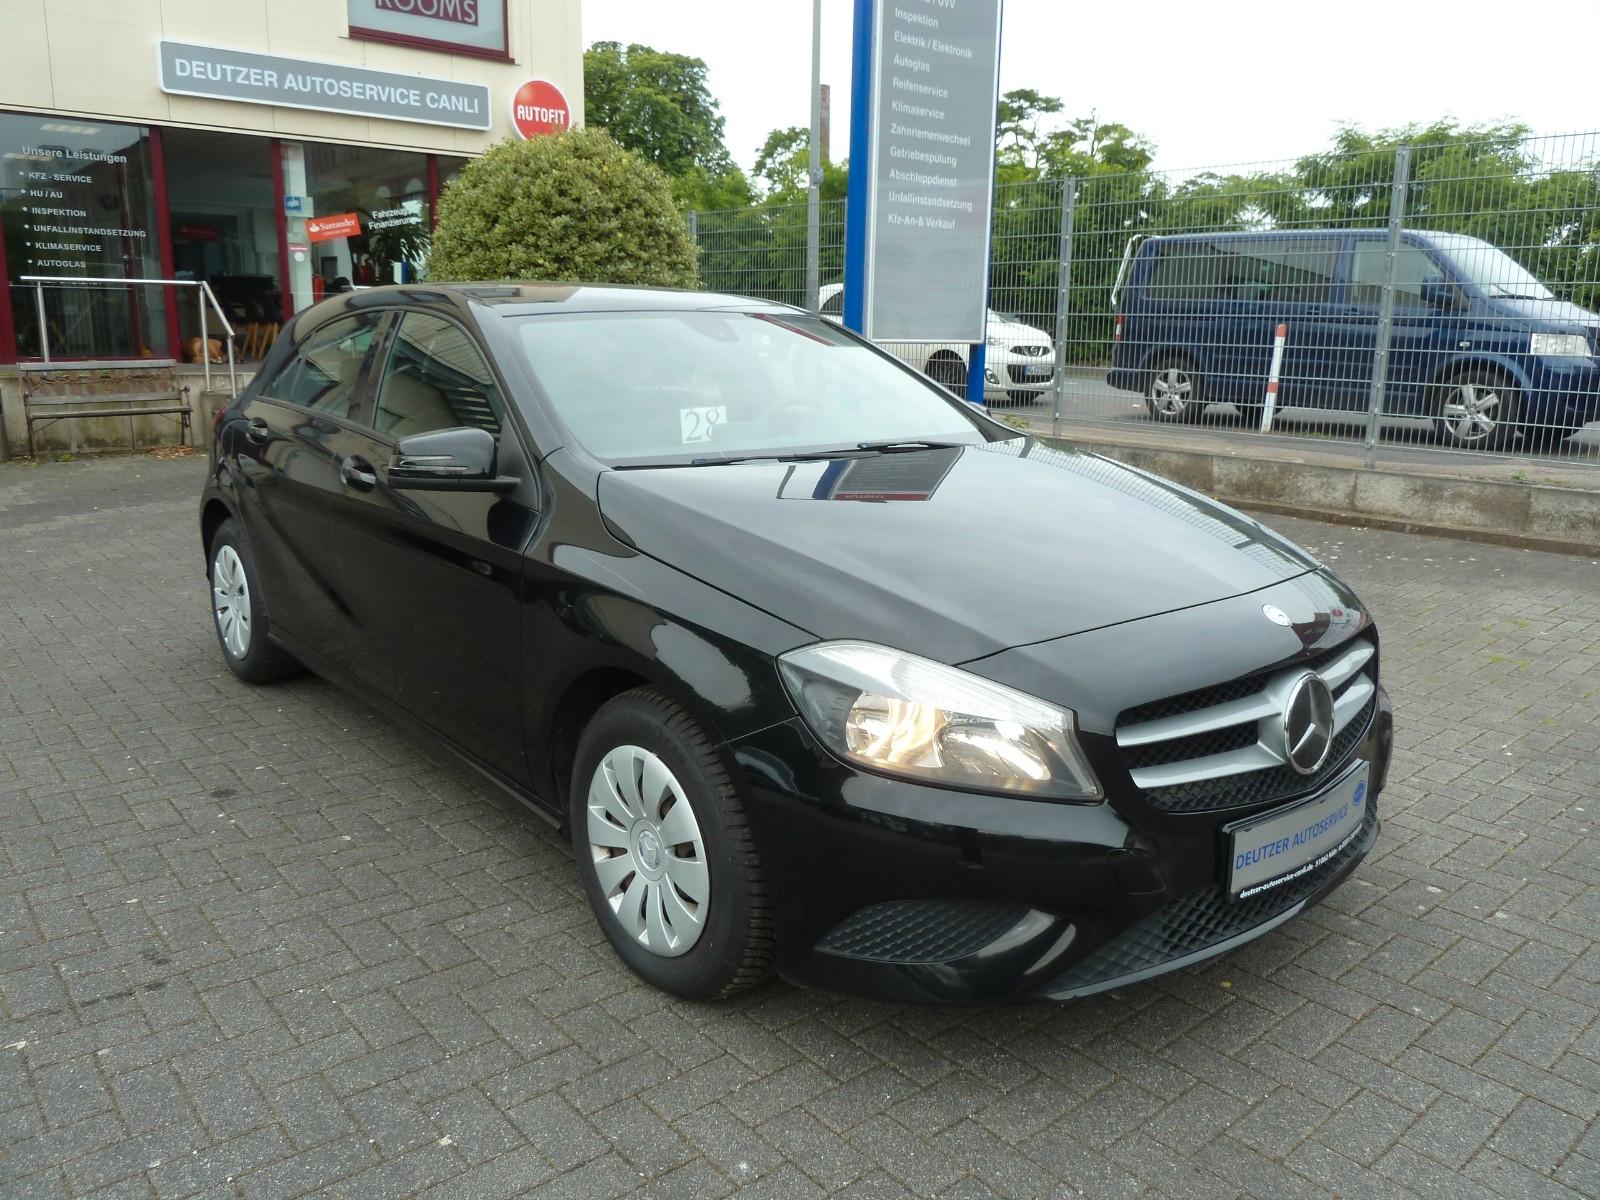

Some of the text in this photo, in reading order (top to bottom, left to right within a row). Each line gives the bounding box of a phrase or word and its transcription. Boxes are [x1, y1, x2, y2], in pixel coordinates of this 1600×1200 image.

[895, 7, 939, 28] Inspektion
[894, 31, 926, 49] Elektrik
[932, 40, 973, 59] Elektronik
[894, 54, 931, 73] Autoglas
[175, 58, 479, 115] DEUTZER AUTOSERVICE CANLI
[892, 77, 948, 99] Reifenservice
[517, 104, 566, 125] AUTOFIT
[892, 100, 945, 120] Klimaservice
[890, 122, 971, 147] Zahnriemenwechsel
[22, 146, 128, 164] Unsere Leistungen
[890, 146, 957, 168] Getriebespülung
[28, 172, 47, 180] KFZ
[54, 174, 93, 184] SERVICE
[889, 168, 958, 188] Abschleppdienst
[30, 189, 44, 198] HU
[50, 191, 63, 199] AU
[888, 191, 973, 213] Unfallinstandsetzung
[31, 207, 87, 217] INSPEKTION
[33, 224, 147, 238] UNFALLINSTANDSETZUNG
[319, 218, 356, 231] Santander
[926, 217, 956, 230] Verkauf
[35, 241, 102, 252] KLIMASERVICE
[37, 259, 87, 268] AUTOGLAS
[1236, 838, 1289, 870] DEUTZER
[1292, 805, 1349, 848] AUTOSERVICE
